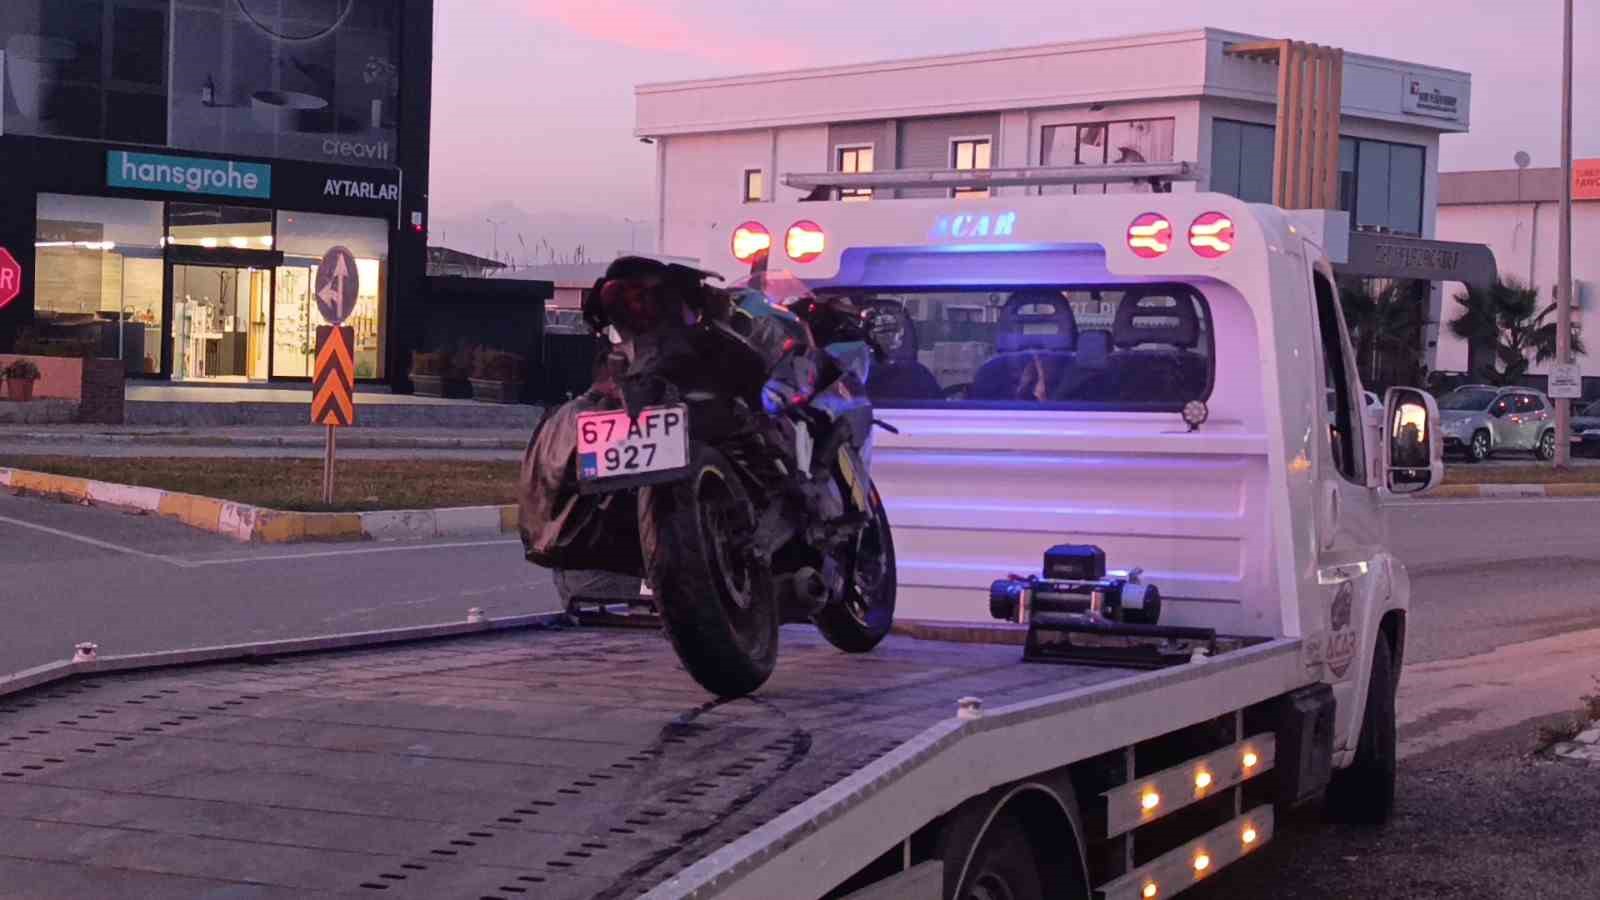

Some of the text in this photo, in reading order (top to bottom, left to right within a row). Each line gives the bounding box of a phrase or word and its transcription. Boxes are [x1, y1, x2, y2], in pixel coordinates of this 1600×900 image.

[122, 151, 258, 191] hansgrohe
[323, 179, 399, 200] AYTARLAR
[582, 412, 679, 444] 67 AFP
[604, 443, 657, 471] 927
